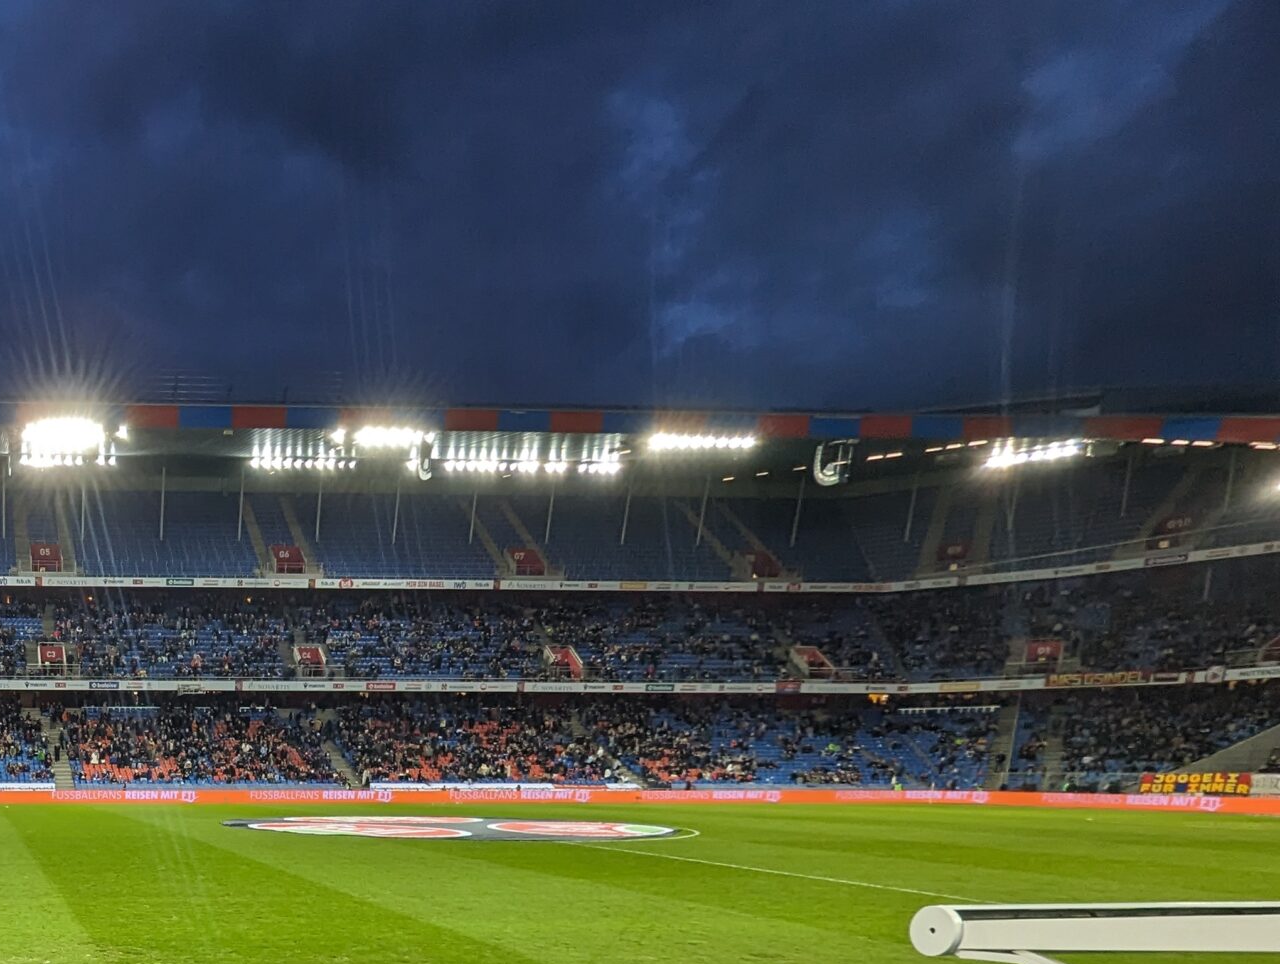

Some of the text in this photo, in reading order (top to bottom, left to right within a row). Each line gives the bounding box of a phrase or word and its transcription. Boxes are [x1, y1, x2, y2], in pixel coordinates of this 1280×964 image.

[52, 790, 122, 801] FUSSBALLFANS
[124, 790, 157, 801] REISEN
[160, 790, 178, 800] MIT
[250, 790, 319, 801] FUSSBALLFANS
[322, 790, 355, 801] REISEN
[358, 790, 375, 800] MIT
[449, 790, 518, 801] FUSSBALLFANS
[520, 790, 552, 800] REISEN
[555, 790, 572, 800] MIT
[712, 789, 743, 801] REISEN
[745, 790, 762, 801] MIT
